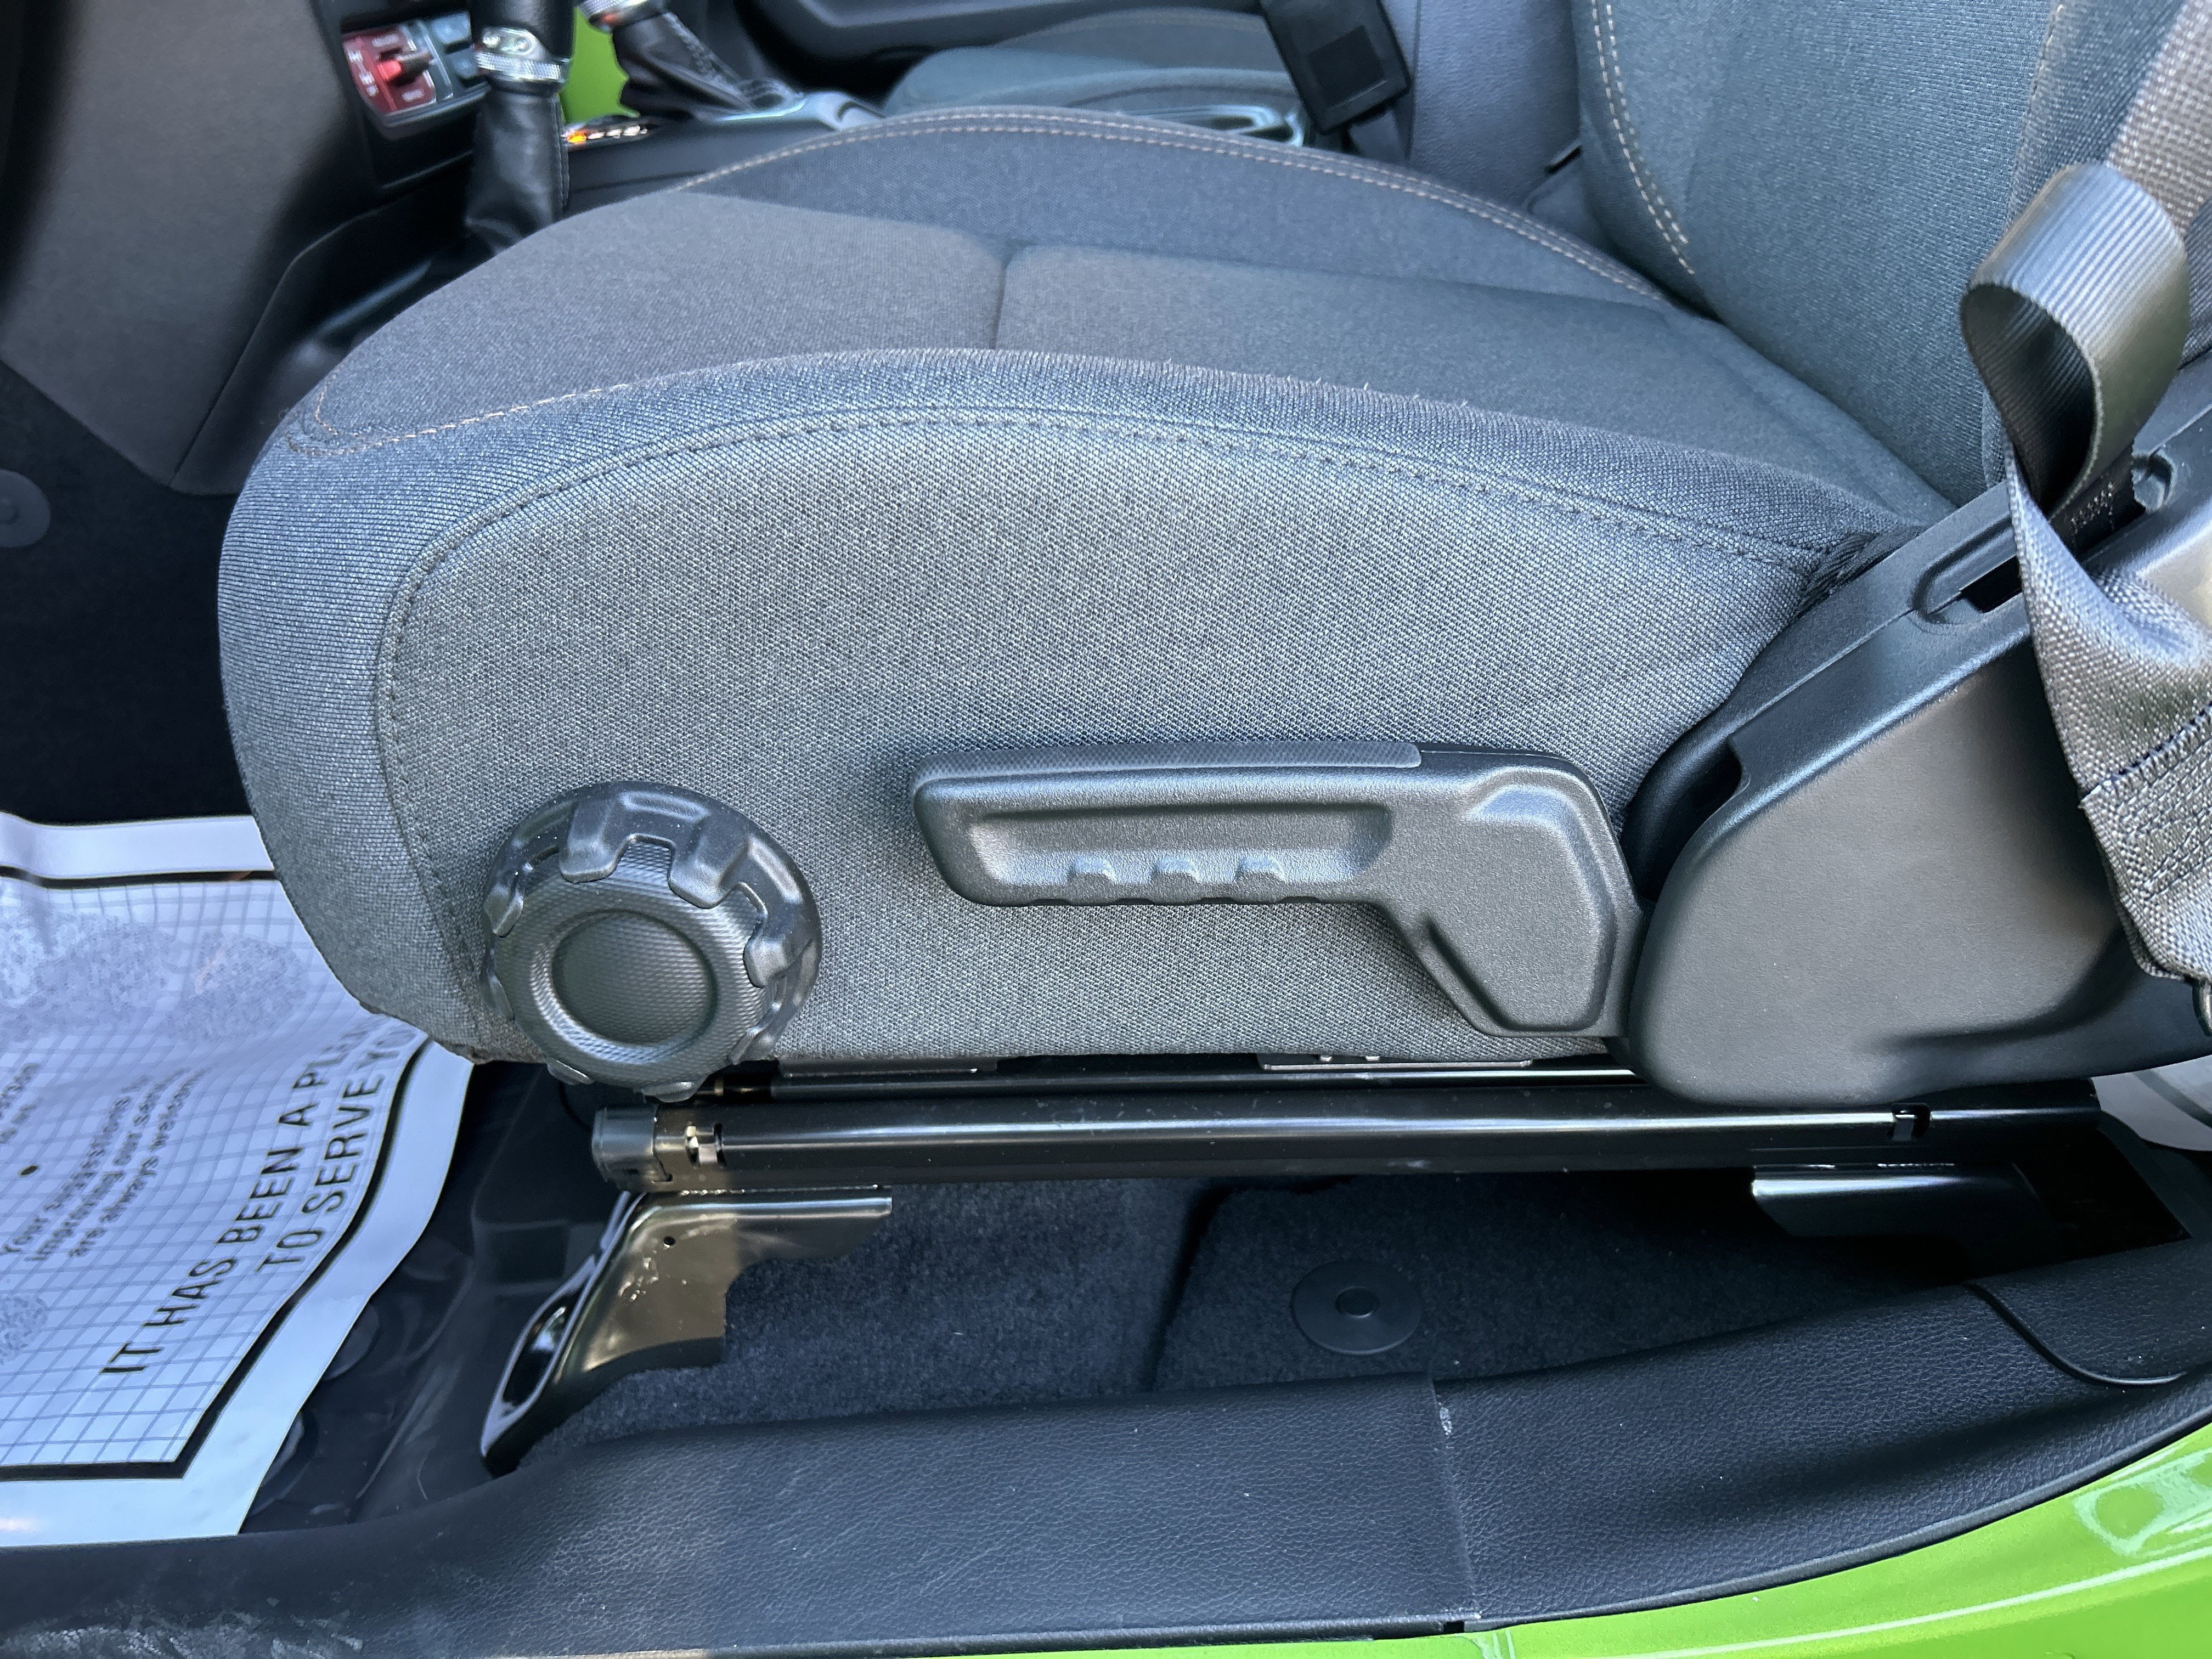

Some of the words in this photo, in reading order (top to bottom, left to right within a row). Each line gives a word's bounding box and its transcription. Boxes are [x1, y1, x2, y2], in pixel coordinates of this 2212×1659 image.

[98, 1341, 163, 1374] IT
[141, 1257, 237, 1327] HAS
[215, 1146, 303, 1244] BEEN
[278, 1101, 320, 1127] A
[254, 1228, 324, 1274] TO
[302, 1074, 385, 1215] SERVE
